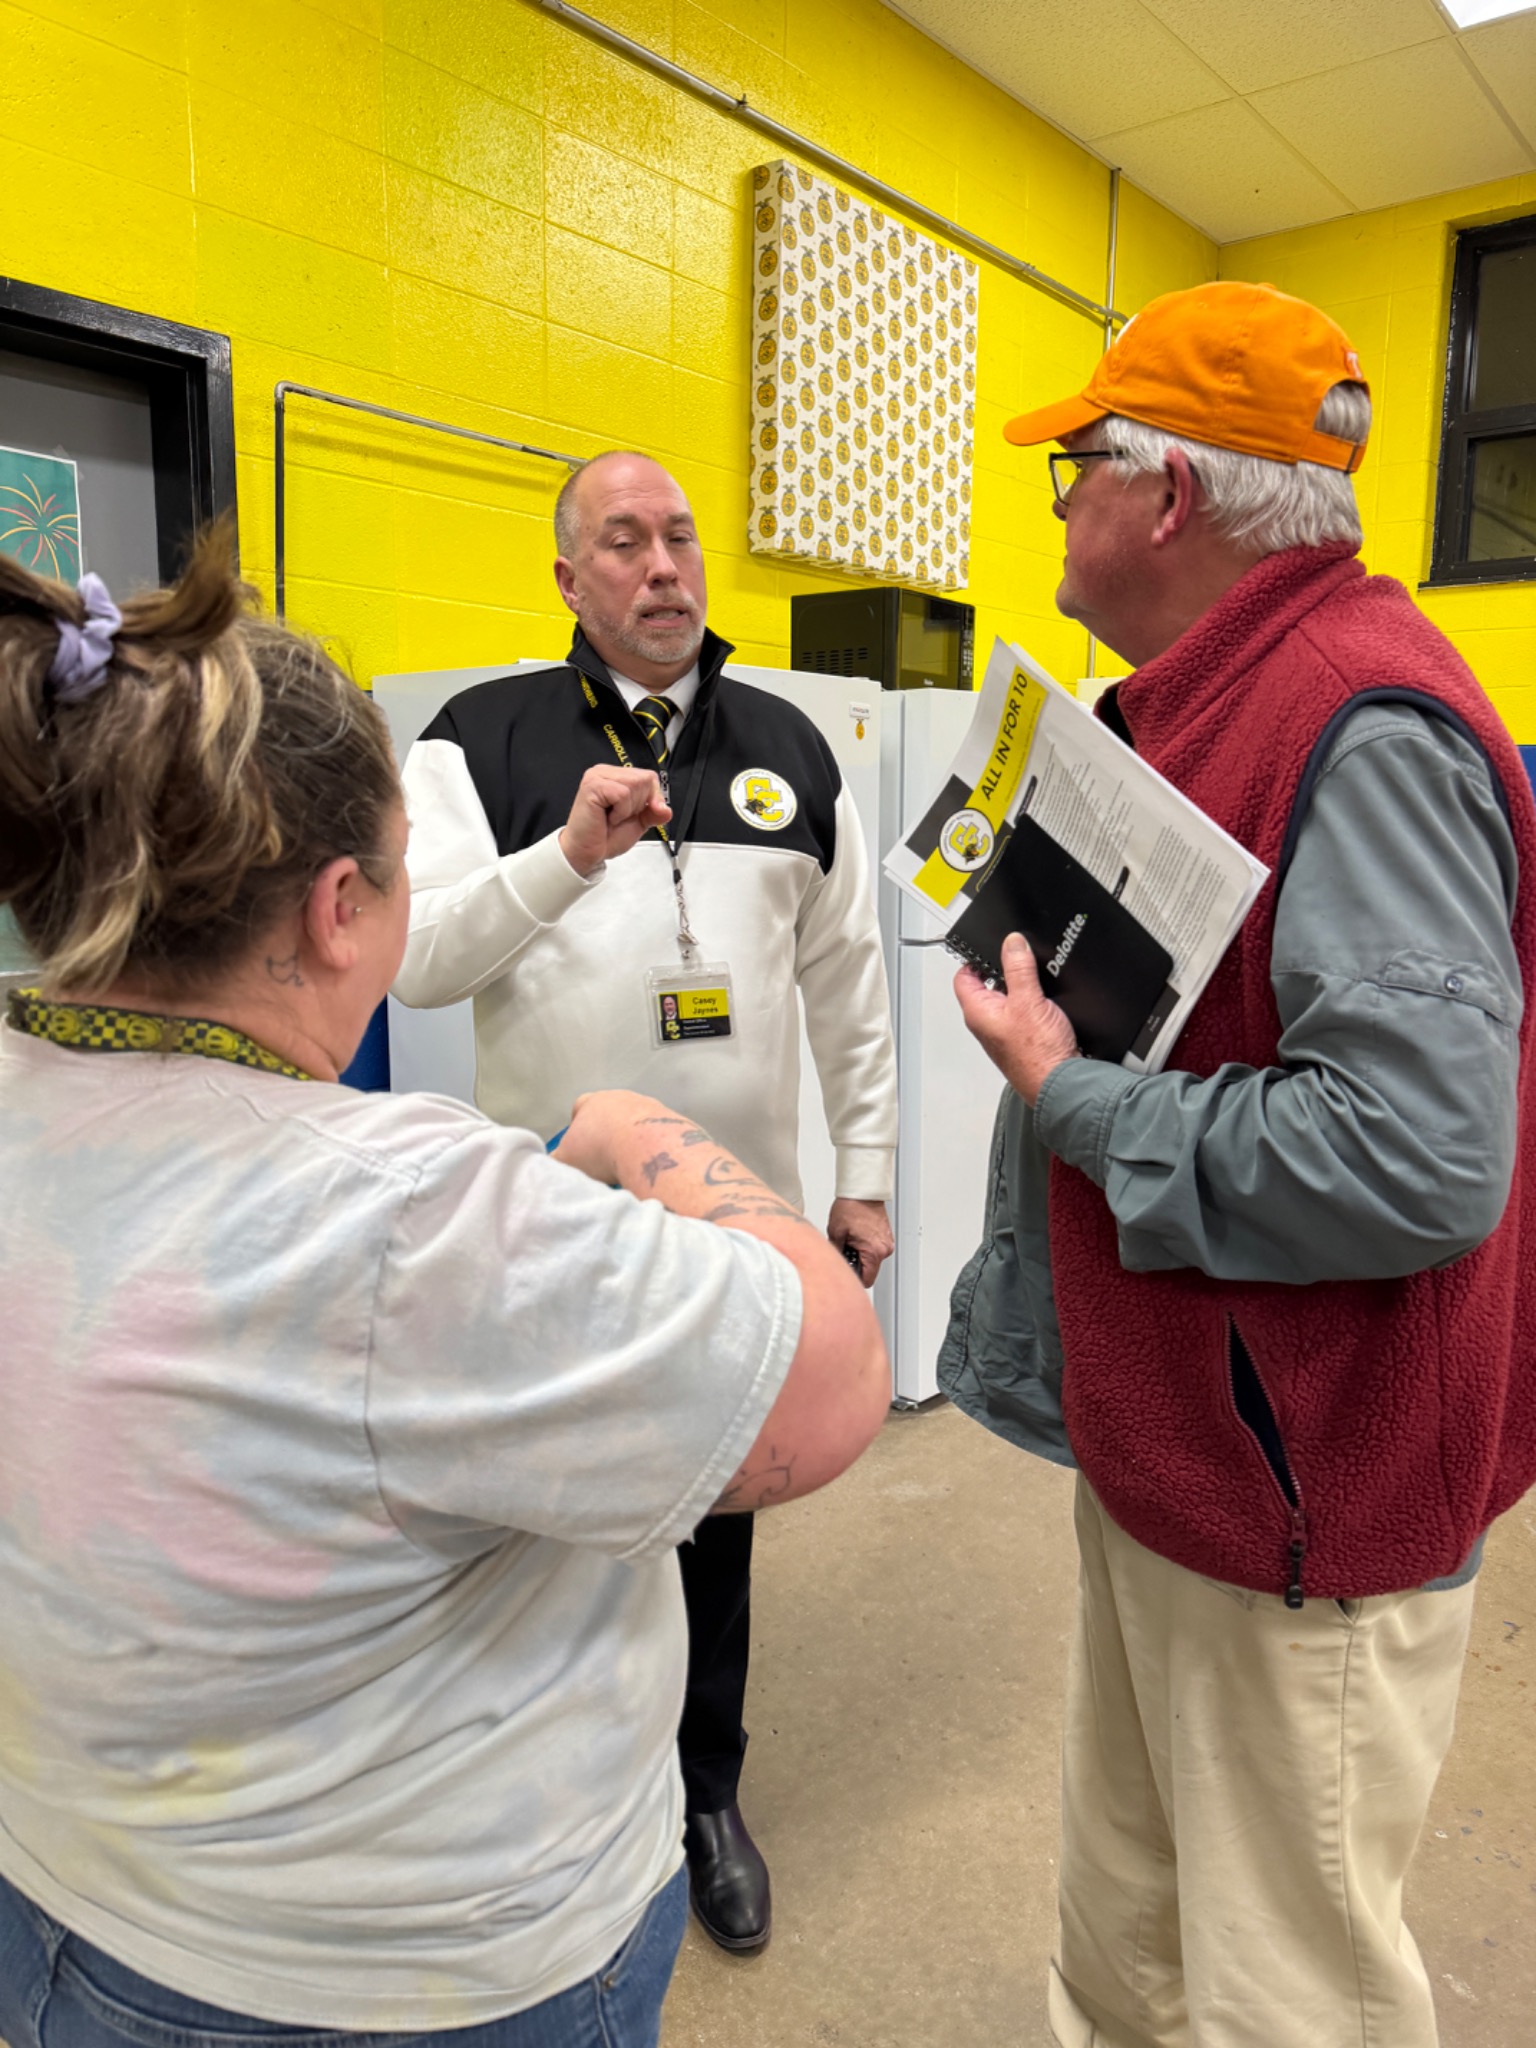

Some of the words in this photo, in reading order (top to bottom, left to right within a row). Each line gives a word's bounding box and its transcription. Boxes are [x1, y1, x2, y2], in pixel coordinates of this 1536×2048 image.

[1013, 672, 1029, 698] 10
[1003, 698, 1022, 740] FOR
[603, 724, 628, 762] CARROLL
[995, 739, 1012, 766] IN
[981, 768, 1003, 801] ALL
